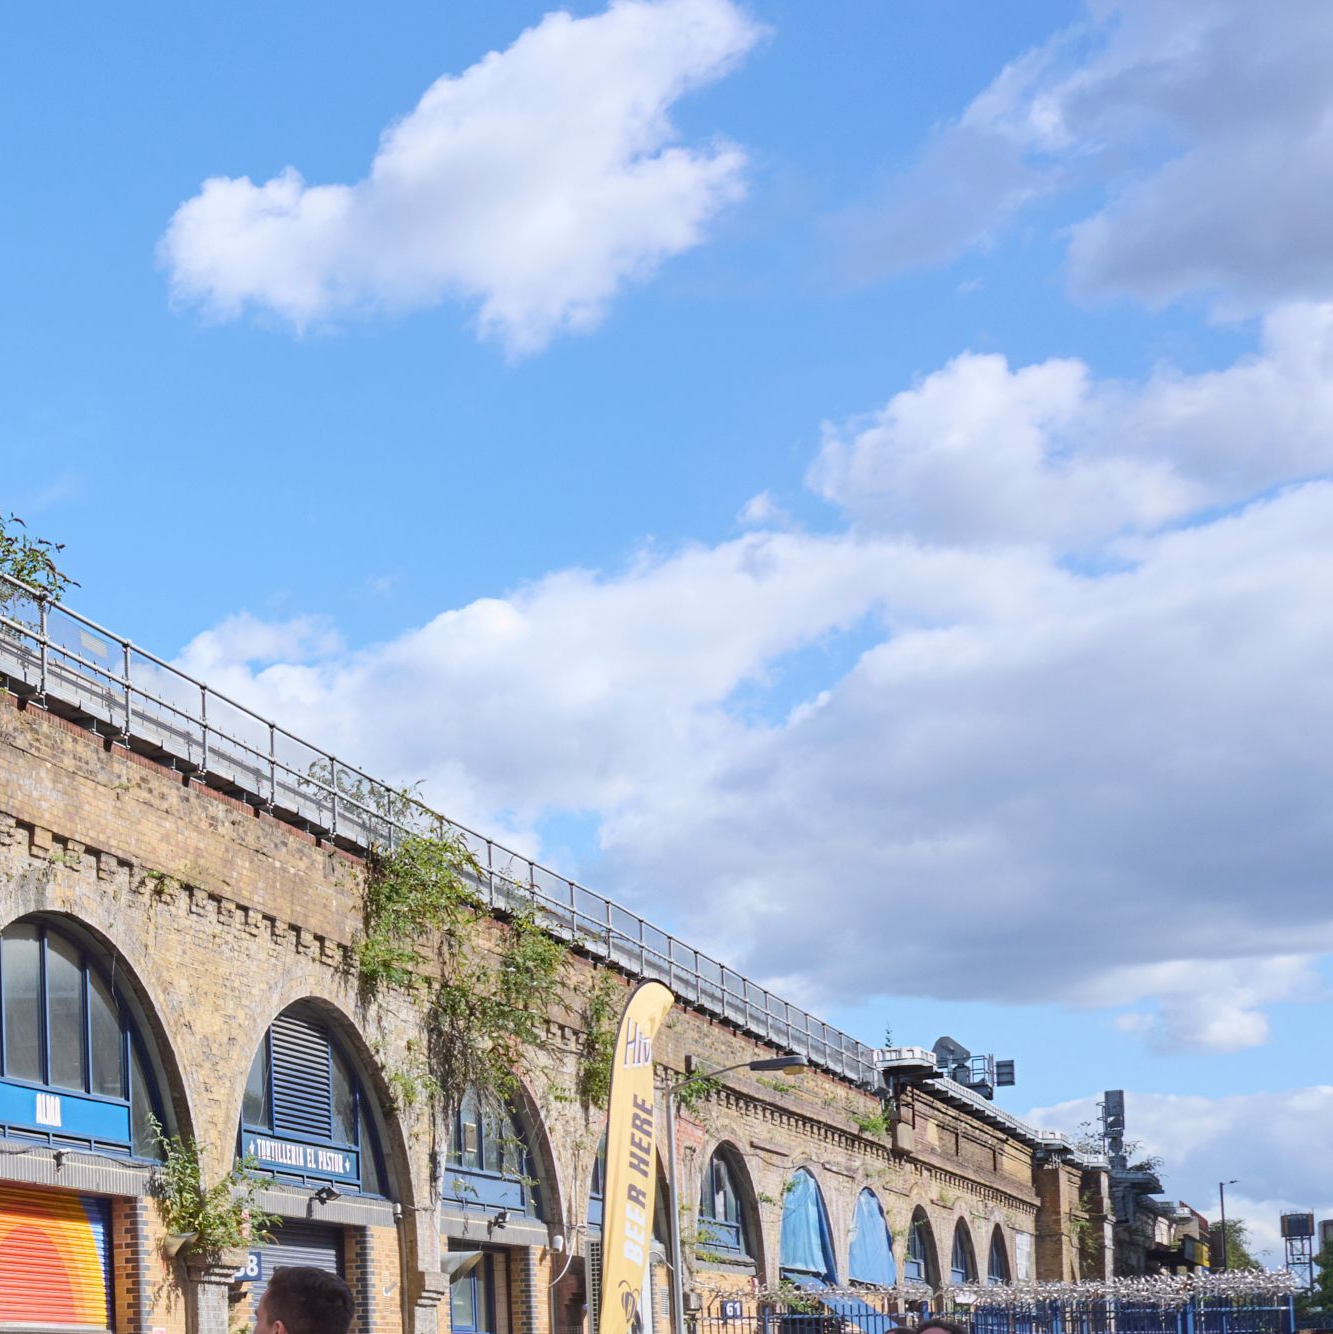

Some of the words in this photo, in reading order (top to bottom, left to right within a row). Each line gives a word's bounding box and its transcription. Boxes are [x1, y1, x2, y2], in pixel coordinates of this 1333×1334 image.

[257, 1139, 304, 1166] TORTILLERIA
[307, 1148, 316, 1168] EL
[319, 1151, 344, 1173] PASTOR
[629, 1094, 654, 1178] HERE
[623, 1183, 646, 1267] BEER
[726, 1302, 741, 1316] 61
